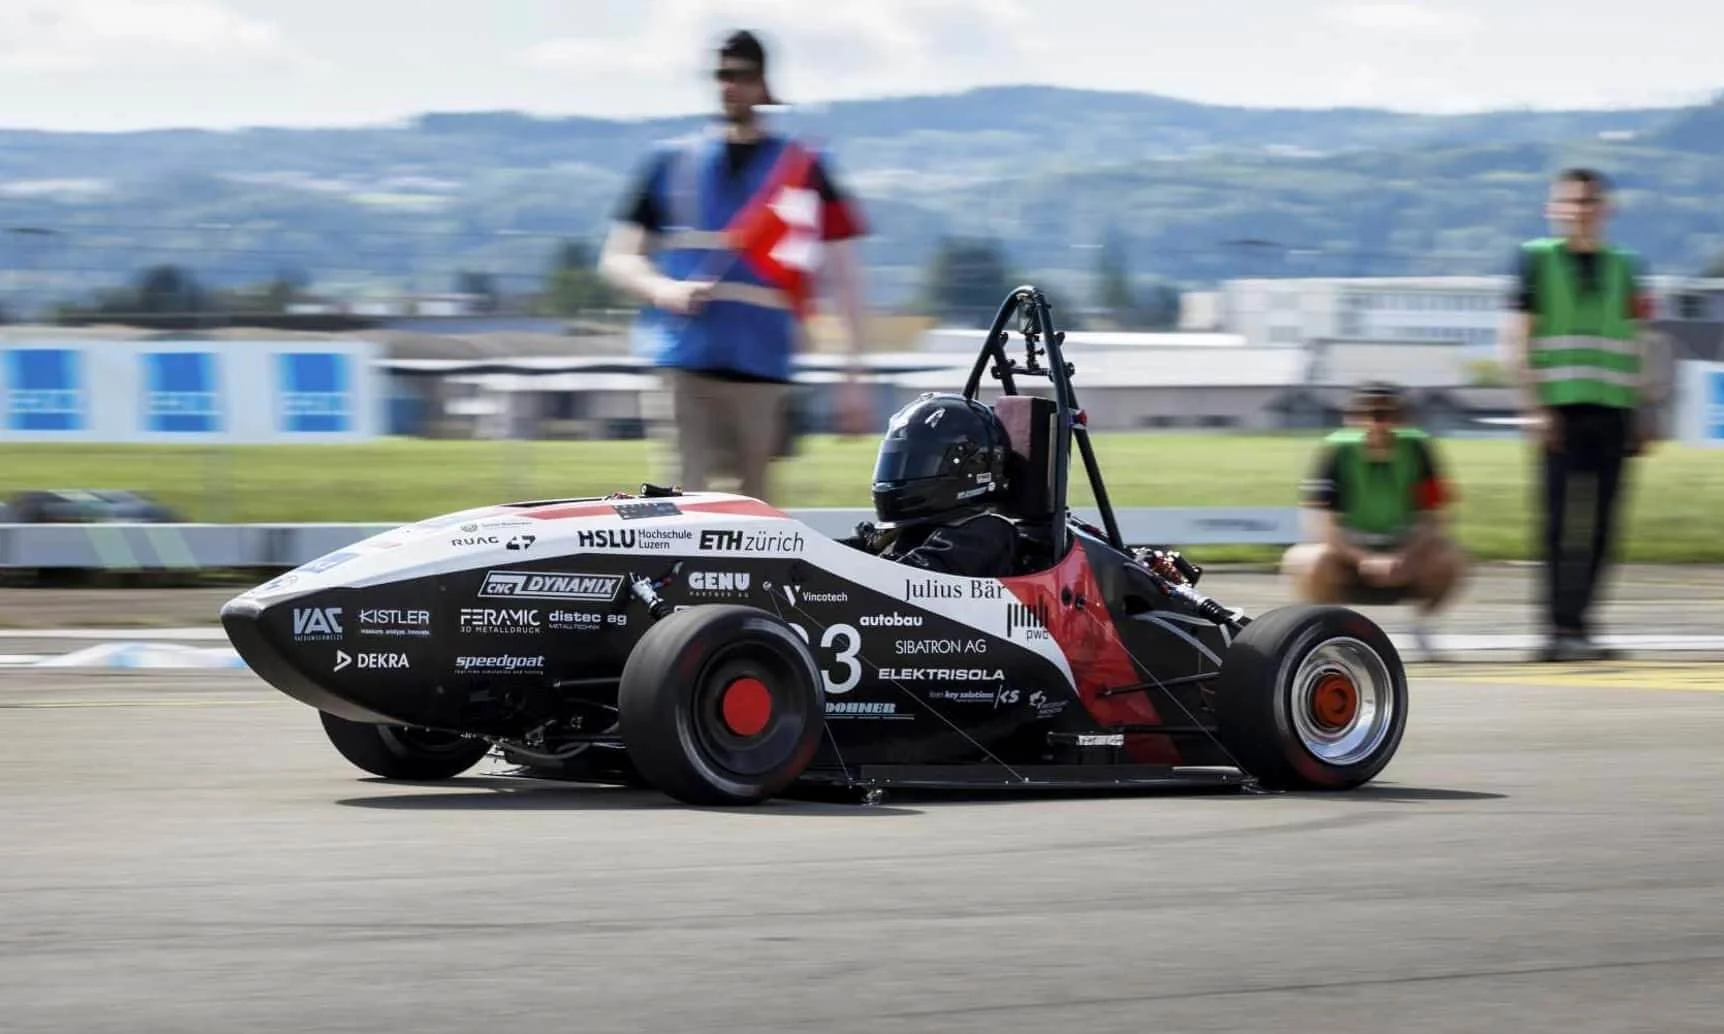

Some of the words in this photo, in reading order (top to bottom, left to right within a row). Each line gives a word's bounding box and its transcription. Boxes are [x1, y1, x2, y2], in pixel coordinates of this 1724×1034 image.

[451, 536, 500, 547] RUAG
[578, 529, 635, 548] HSLU
[638, 529, 692, 541] Hochschule
[699, 530, 743, 550] ETH
[745, 531, 804, 552] zürich
[639, 540, 669, 549] Luzern
[487, 583, 514, 594] CNC
[527, 576, 617, 594] DYNAMIX
[689, 572, 749, 590] GENU
[802, 591, 848, 602] Vincotech
[905, 579, 962, 602] Julius
[971, 579, 1004, 599] Bär
[293, 608, 343, 634] VAC
[360, 610, 429, 624] KISTLER
[461, 609, 540, 625] FERAMIC
[549, 610, 601, 622] distec
[608, 615, 627, 625] ag
[860, 612, 922, 626] autobau
[475, 626, 541, 634] METALLDRUCK
[896, 640, 960, 654] SIBATRON
[965, 639, 987, 654] AG
[358, 653, 409, 668] DEKRA
[456, 654, 544, 669] speedgoat
[788, 622, 862, 694] 3
[879, 668, 1004, 680] ELEKTRISOLA
